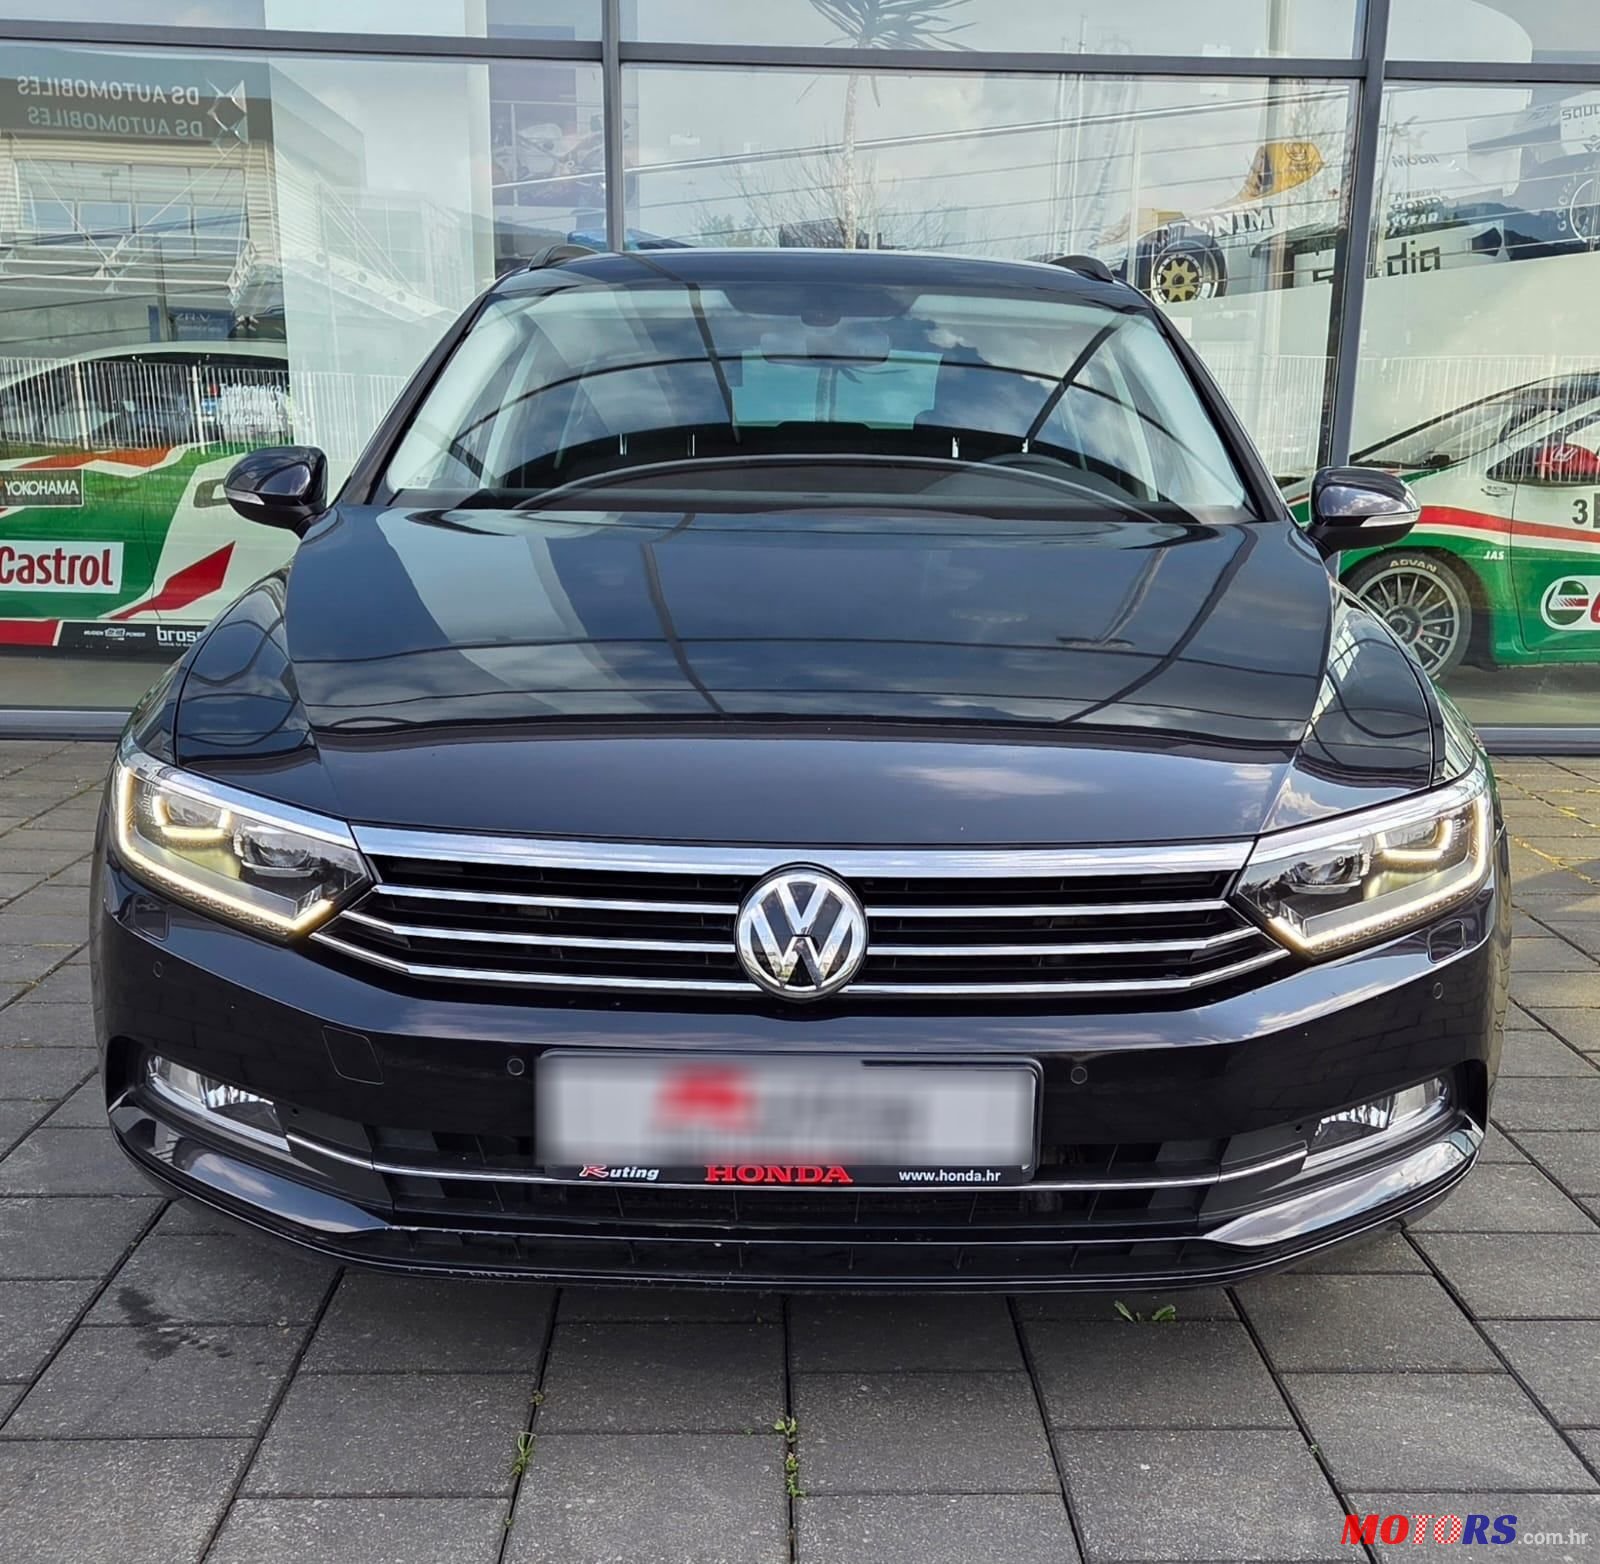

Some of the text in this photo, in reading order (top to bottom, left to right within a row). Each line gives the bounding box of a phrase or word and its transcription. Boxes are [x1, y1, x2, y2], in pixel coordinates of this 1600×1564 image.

[4, 479, 80, 496] YOKOHAMA
[1572, 499, 1588, 525] 3
[1482, 551, 1505, 561] JAS
[0, 546, 114, 586] Castrol
[1390, 559, 1437, 573] ADVAN
[579, 1164, 660, 1181] Ruting
[704, 1164, 853, 1183] HONDA
[899, 1169, 1001, 1182] www.honda.hr
